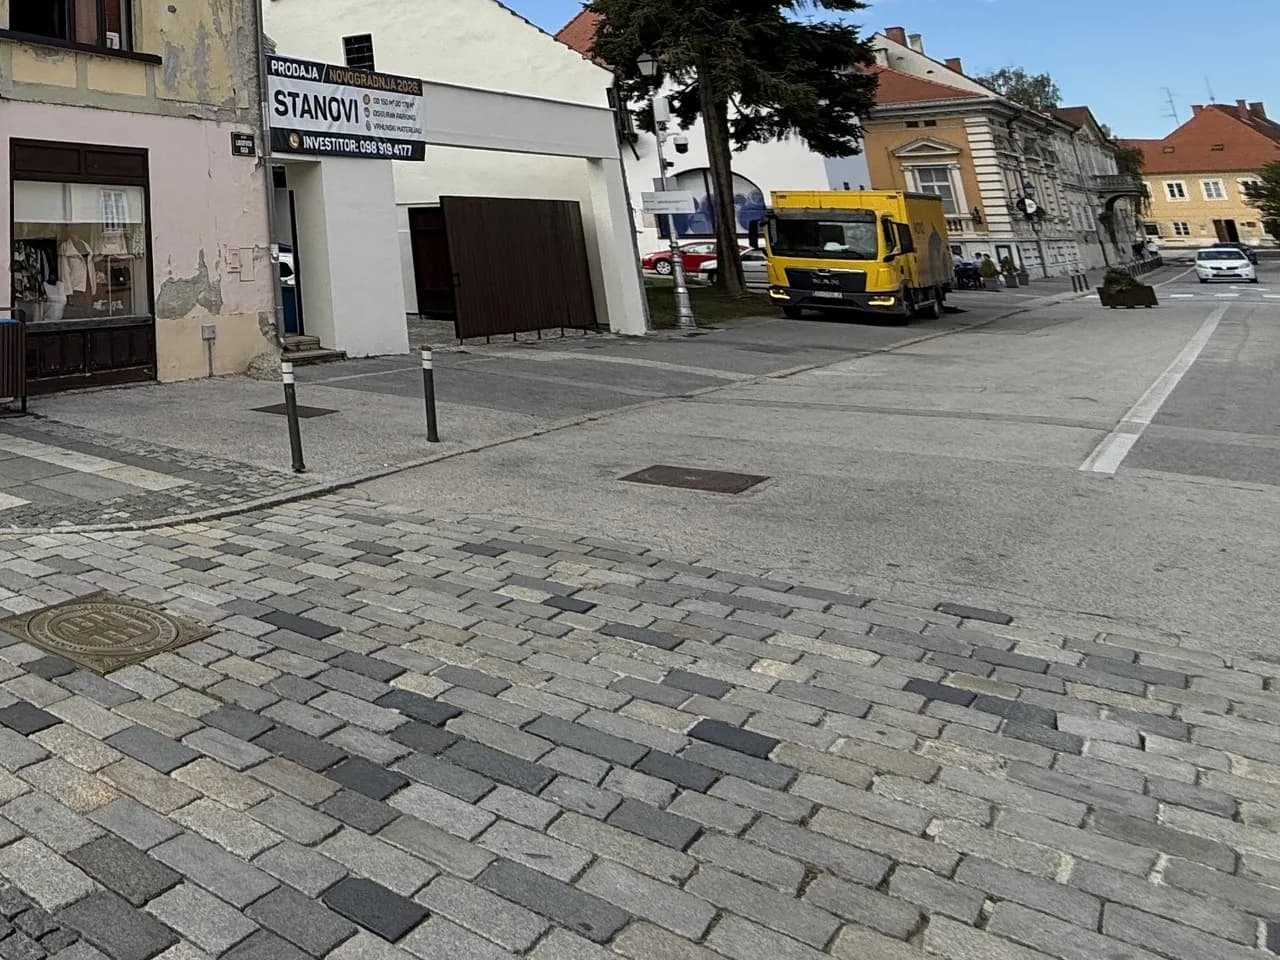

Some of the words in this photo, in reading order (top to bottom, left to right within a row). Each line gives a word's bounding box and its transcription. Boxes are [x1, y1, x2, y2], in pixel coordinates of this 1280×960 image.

[271, 60, 319, 80] PRODAJA
[329, 69, 396, 90] NOVOGRADNJA
[274, 89, 359, 124] STANOVI
[303, 136, 359, 153] INVESTITOR:
[360, 142, 378, 154] 098
[378, 144, 393, 156] 919
[394, 144, 413, 157] 4177
